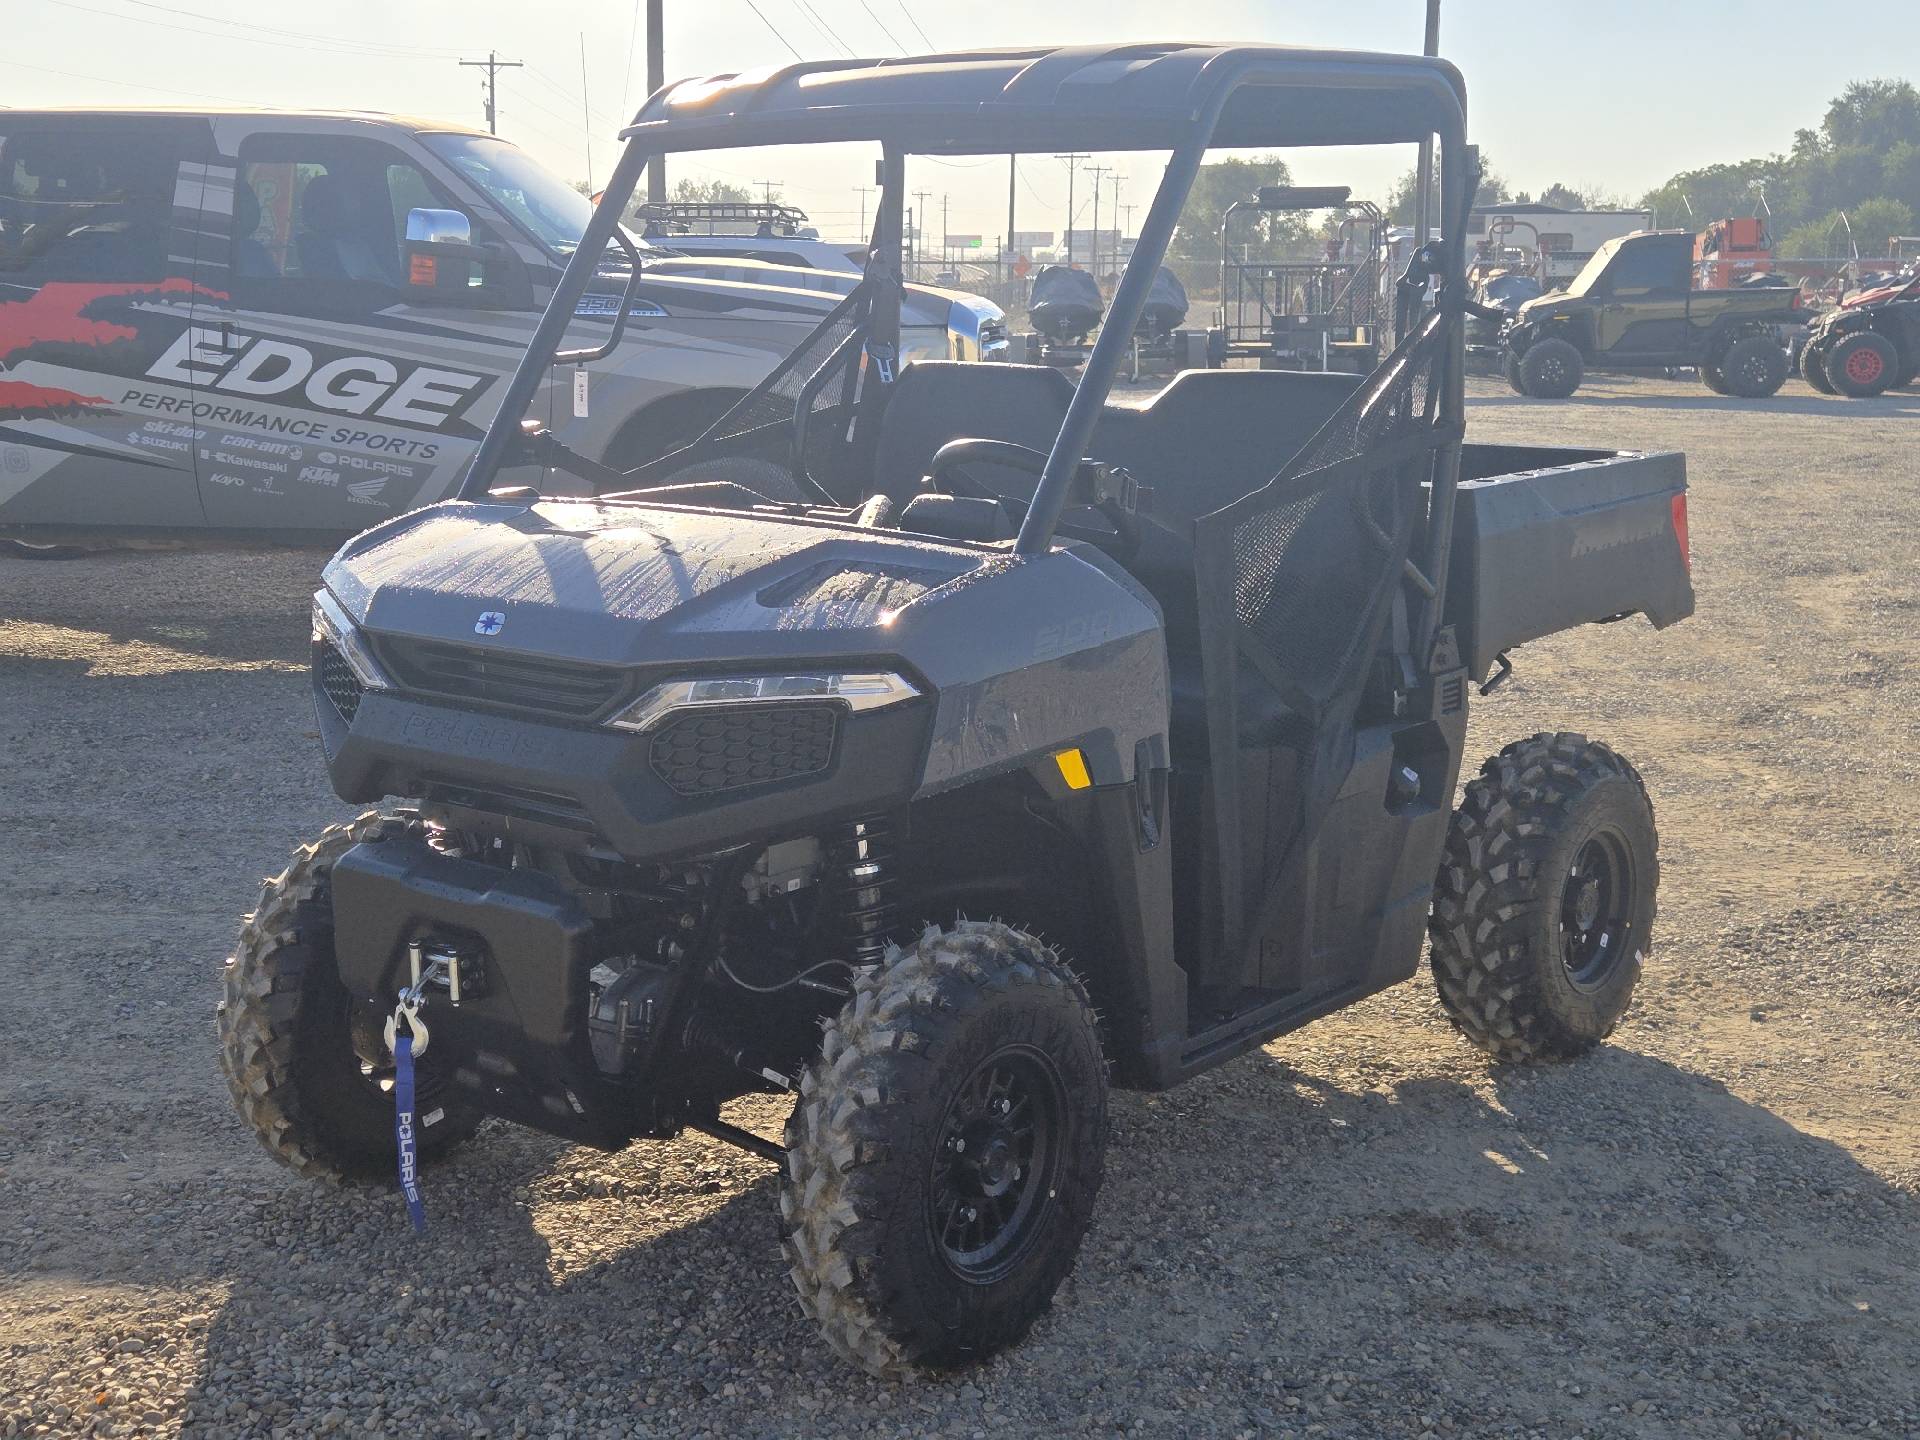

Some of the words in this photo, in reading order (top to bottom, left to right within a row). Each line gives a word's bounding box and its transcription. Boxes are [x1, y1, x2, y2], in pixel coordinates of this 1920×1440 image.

[144, 326, 481, 425] EDGE
[120, 389, 328, 440] PERFORMANCE
[331, 425, 439, 459] SPORTS
[141, 436, 189, 452] SUZUKI
[220, 434, 288, 455] can-am
[226, 454, 288, 473] Kawasaki
[298, 465, 340, 484] KTM
[338, 455, 414, 478] POLARIS
[347, 495, 391, 508] HONDA
[402, 711, 540, 754] POLARIS
[399, 1112, 418, 1203] POLARIS
